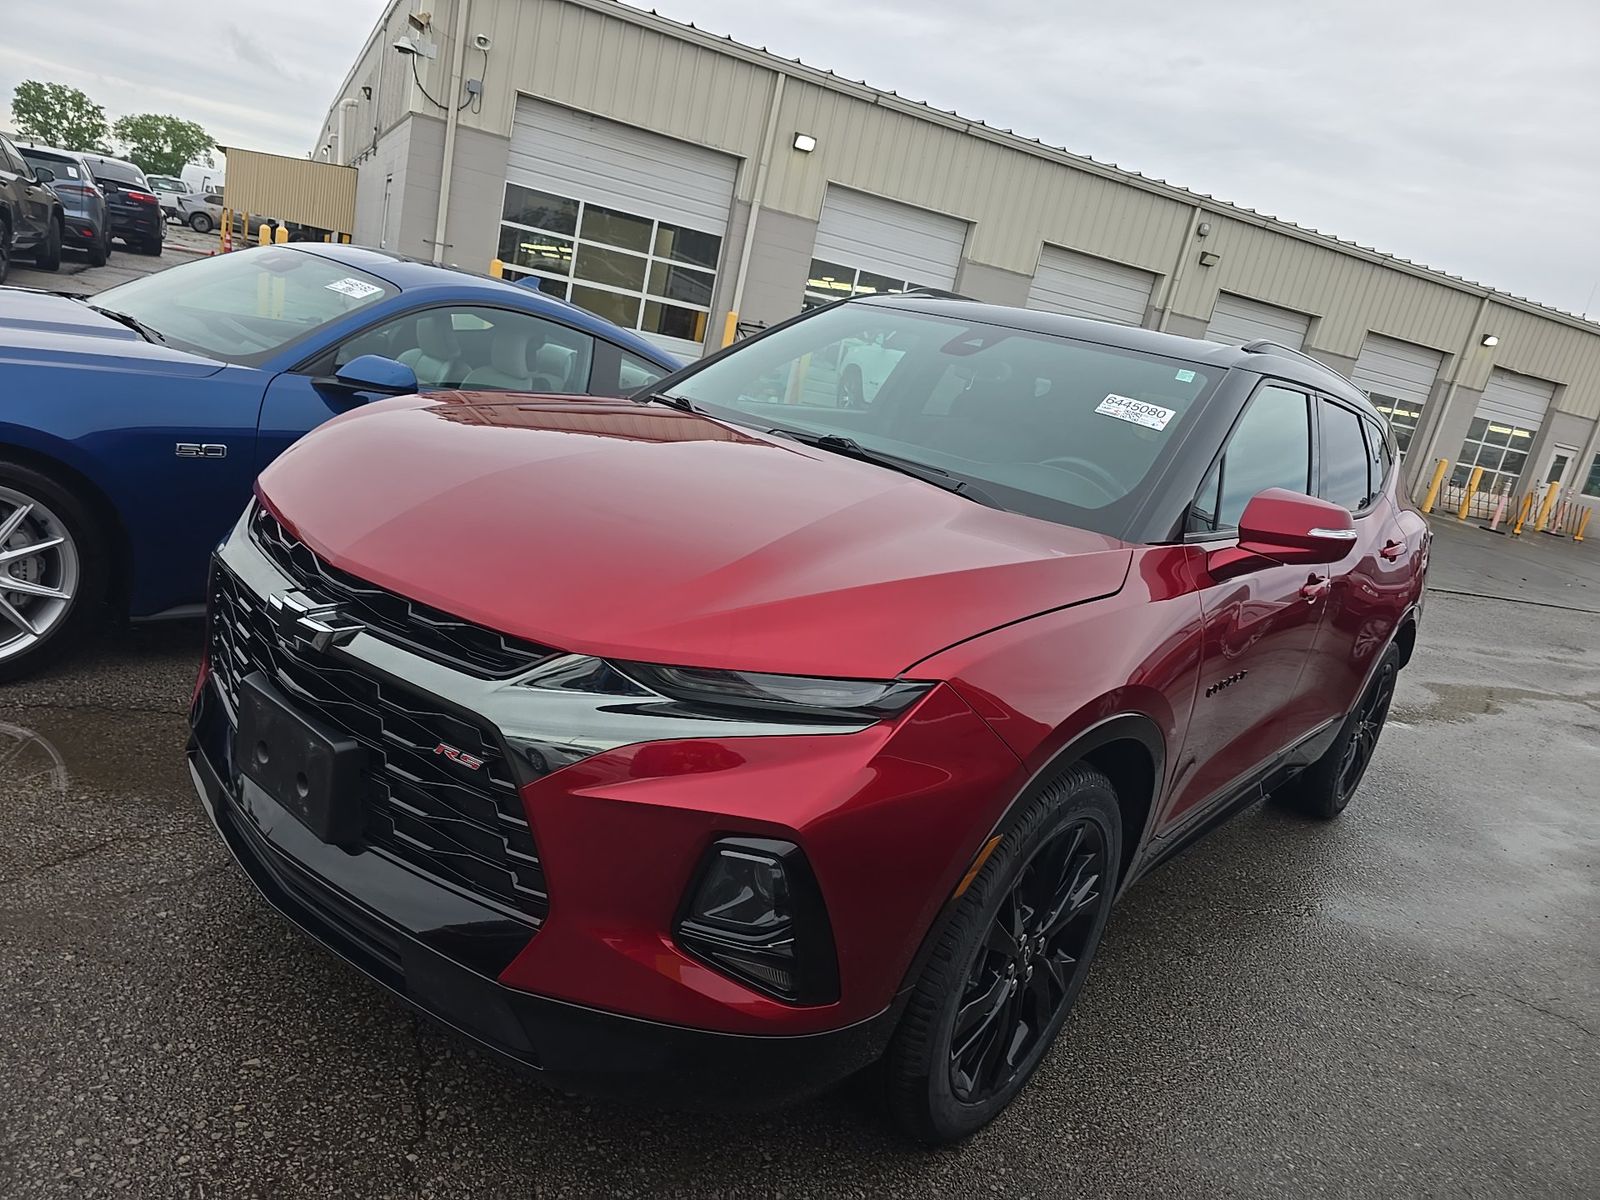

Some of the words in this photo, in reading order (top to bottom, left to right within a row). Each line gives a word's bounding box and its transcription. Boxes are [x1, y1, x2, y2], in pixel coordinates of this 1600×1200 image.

[1105, 396, 1167, 419] 6445080
[175, 443, 228, 458] 5.0
[432, 742, 485, 771] RS
